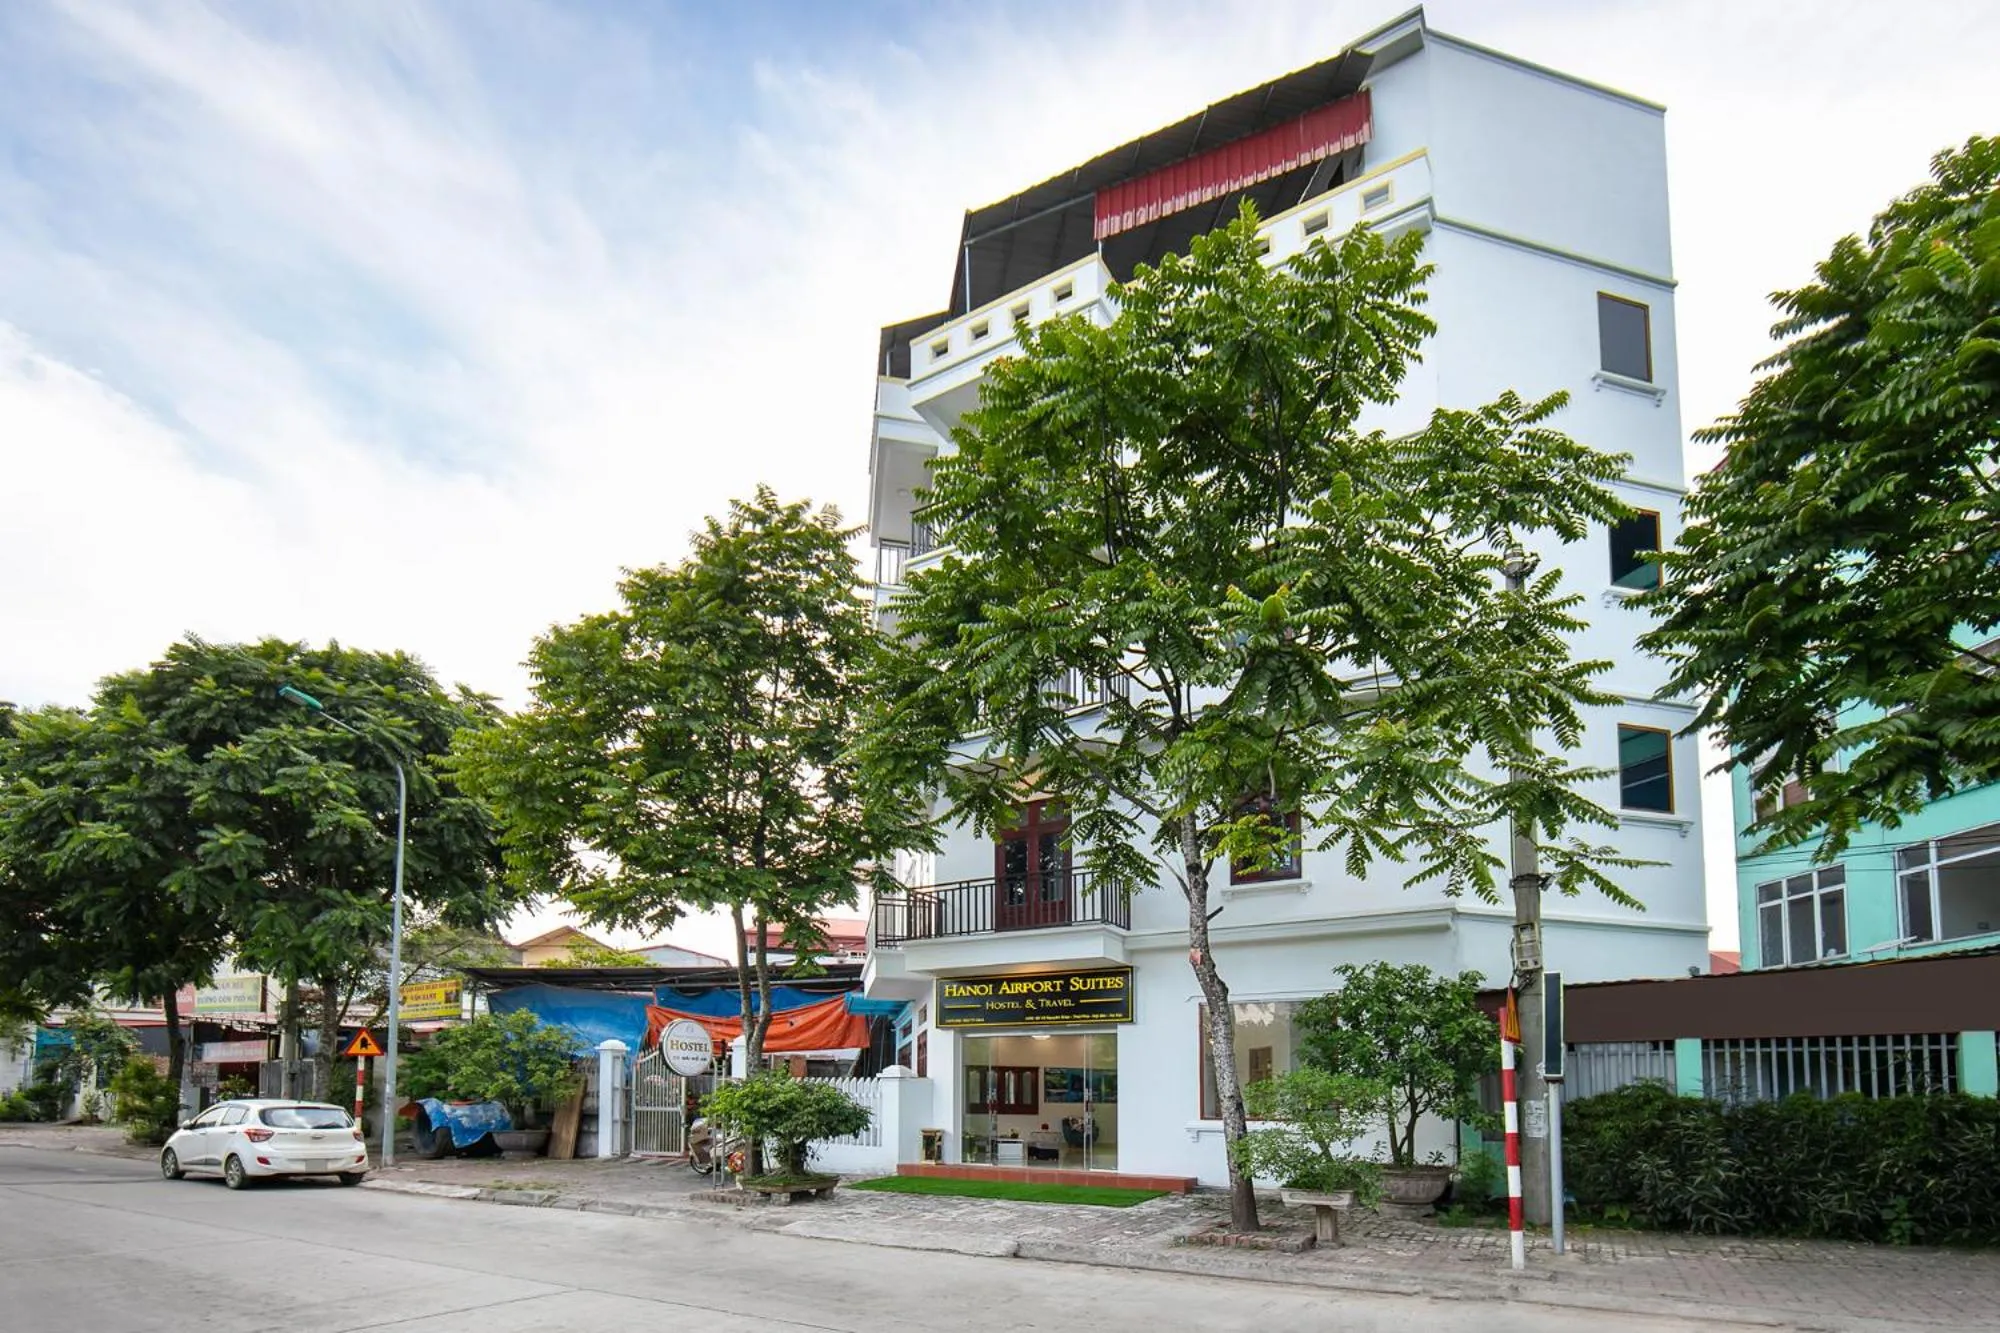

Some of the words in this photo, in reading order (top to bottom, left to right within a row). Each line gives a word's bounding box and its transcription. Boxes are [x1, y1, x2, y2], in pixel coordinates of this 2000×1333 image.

[944, 984, 993, 997] HANOI
[999, 980, 1064, 995] AIRPORT
[1069, 976, 1125, 991] SUITES
[986, 1000, 1022, 1010] HOSTEL
[1025, 1000, 1037, 1010] &
[1040, 998, 1075, 1008] TRAVEL
[670, 1039, 710, 1052] HOSTEL
